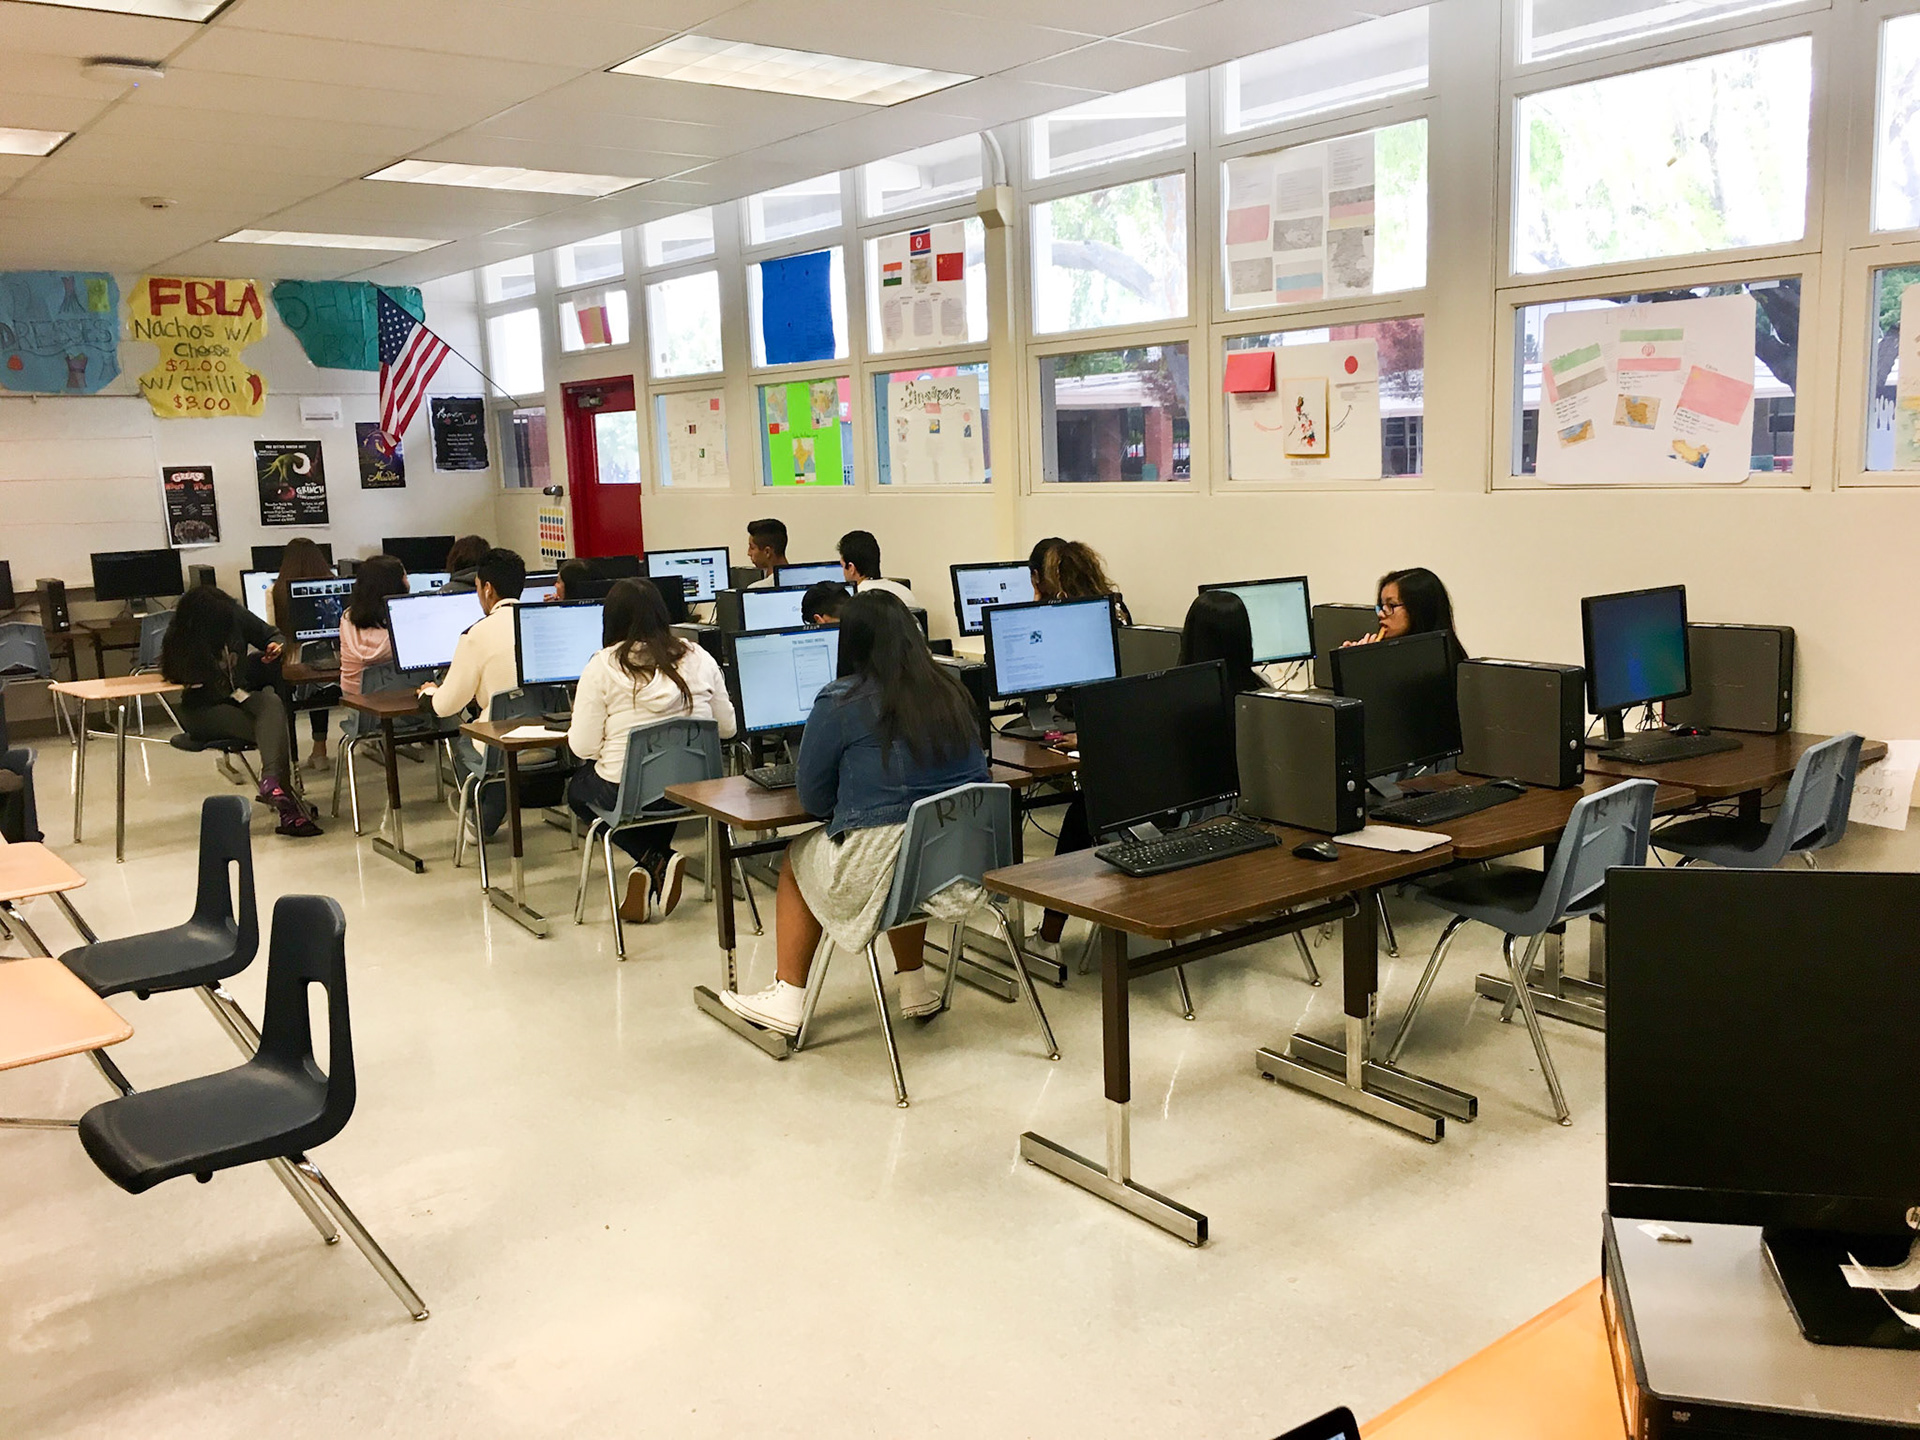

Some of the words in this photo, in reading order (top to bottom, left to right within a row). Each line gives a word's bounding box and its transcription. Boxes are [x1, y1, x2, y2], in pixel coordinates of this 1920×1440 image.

[148, 278, 263, 320] FBLA
[134, 317, 214, 340] Nachos
[165, 358, 227, 372] $2.00
[181, 375, 237, 394] Chilli
[296, 486, 325, 495] GRINCH
